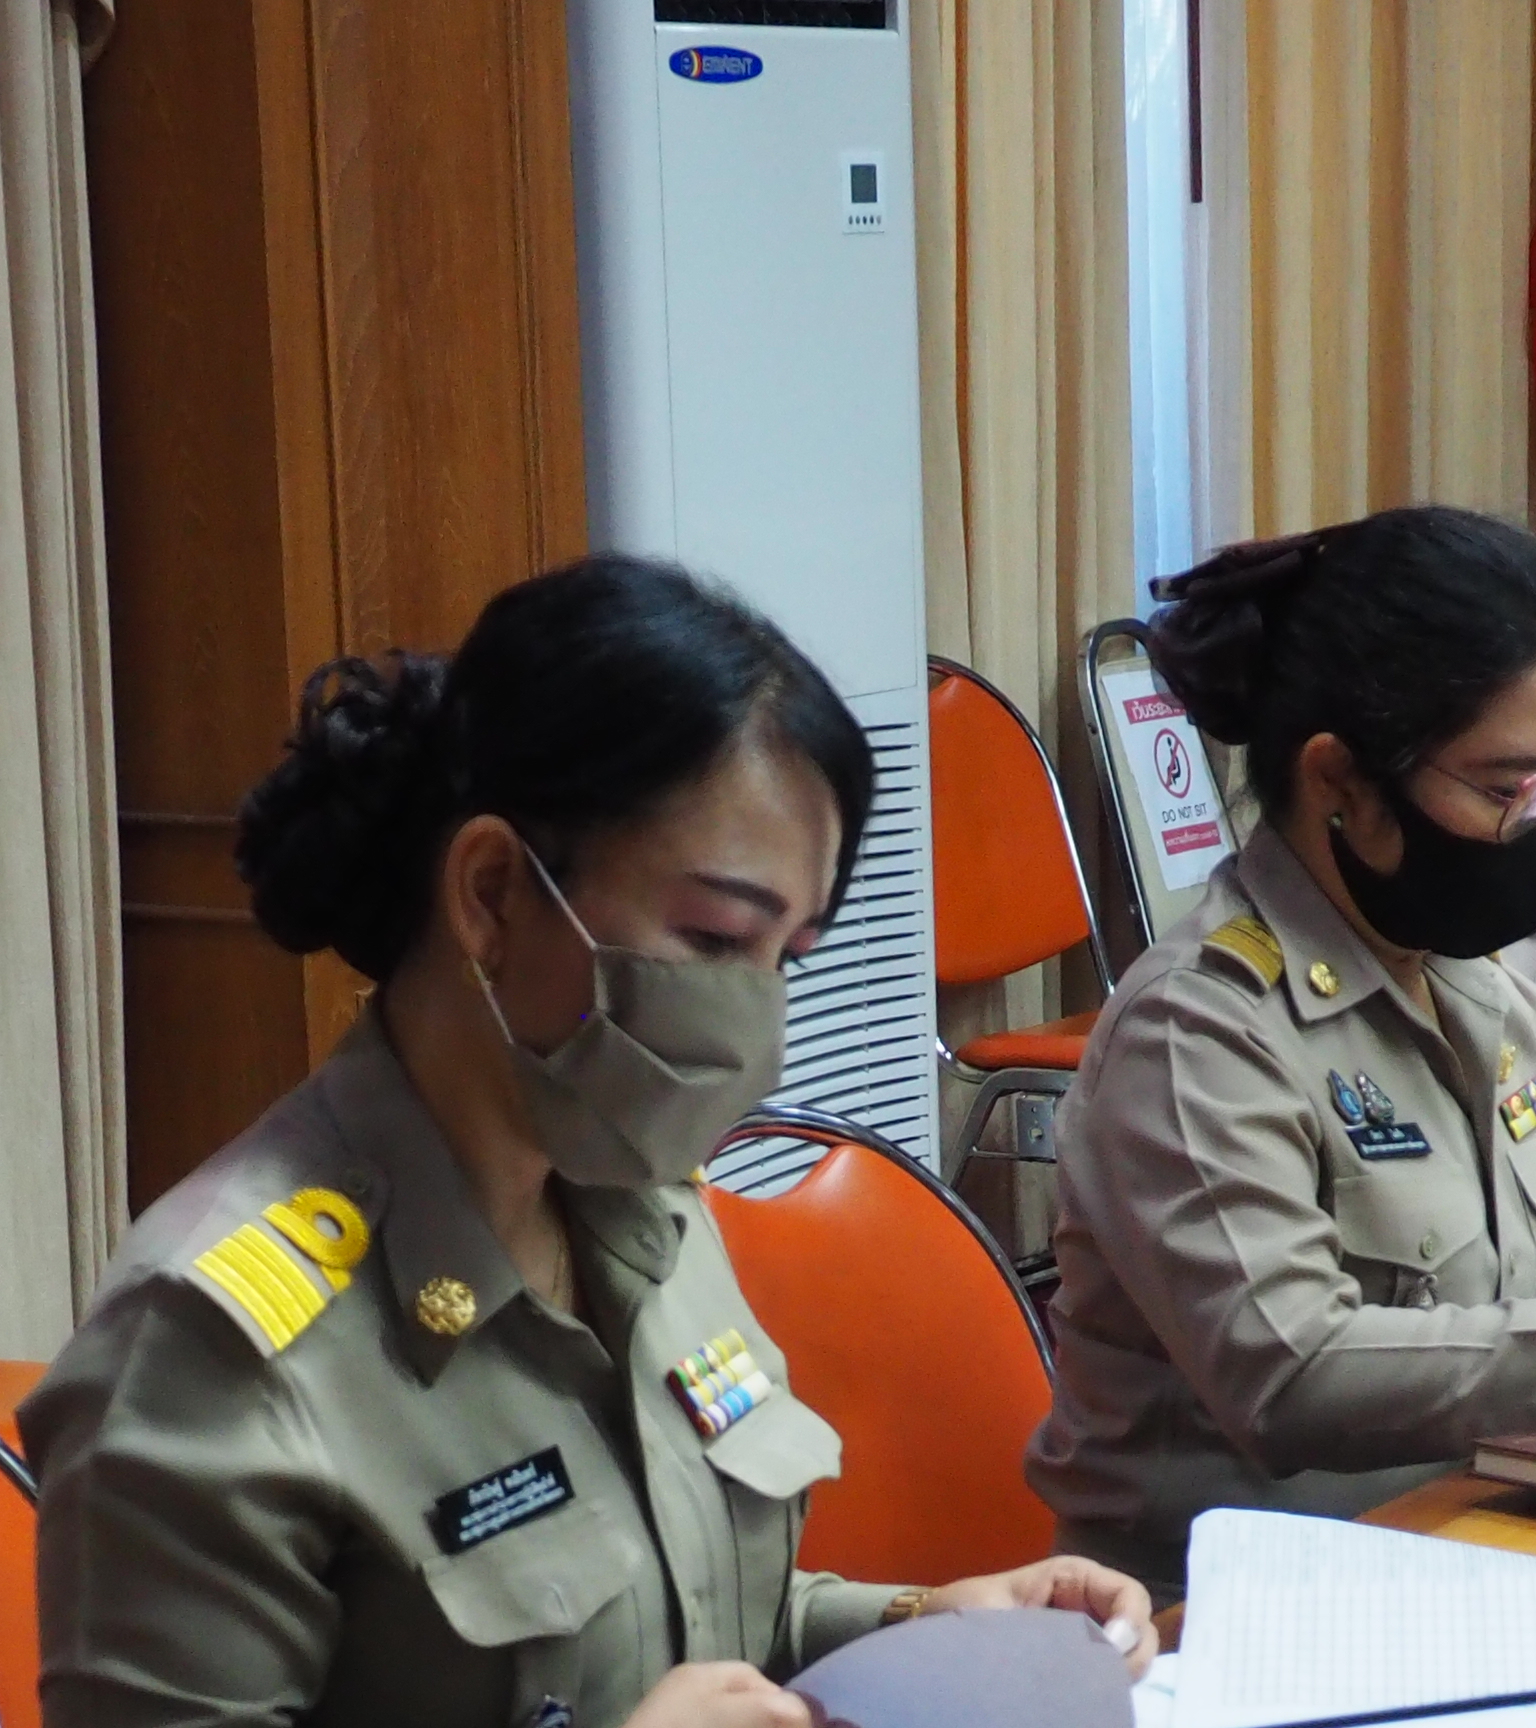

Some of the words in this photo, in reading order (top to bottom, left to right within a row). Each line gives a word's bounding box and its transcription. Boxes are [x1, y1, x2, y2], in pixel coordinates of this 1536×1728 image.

[1162, 808, 1176, 823] DO
[1177, 806, 1192, 820] NOT
[1194, 803, 1207, 817] SIT
